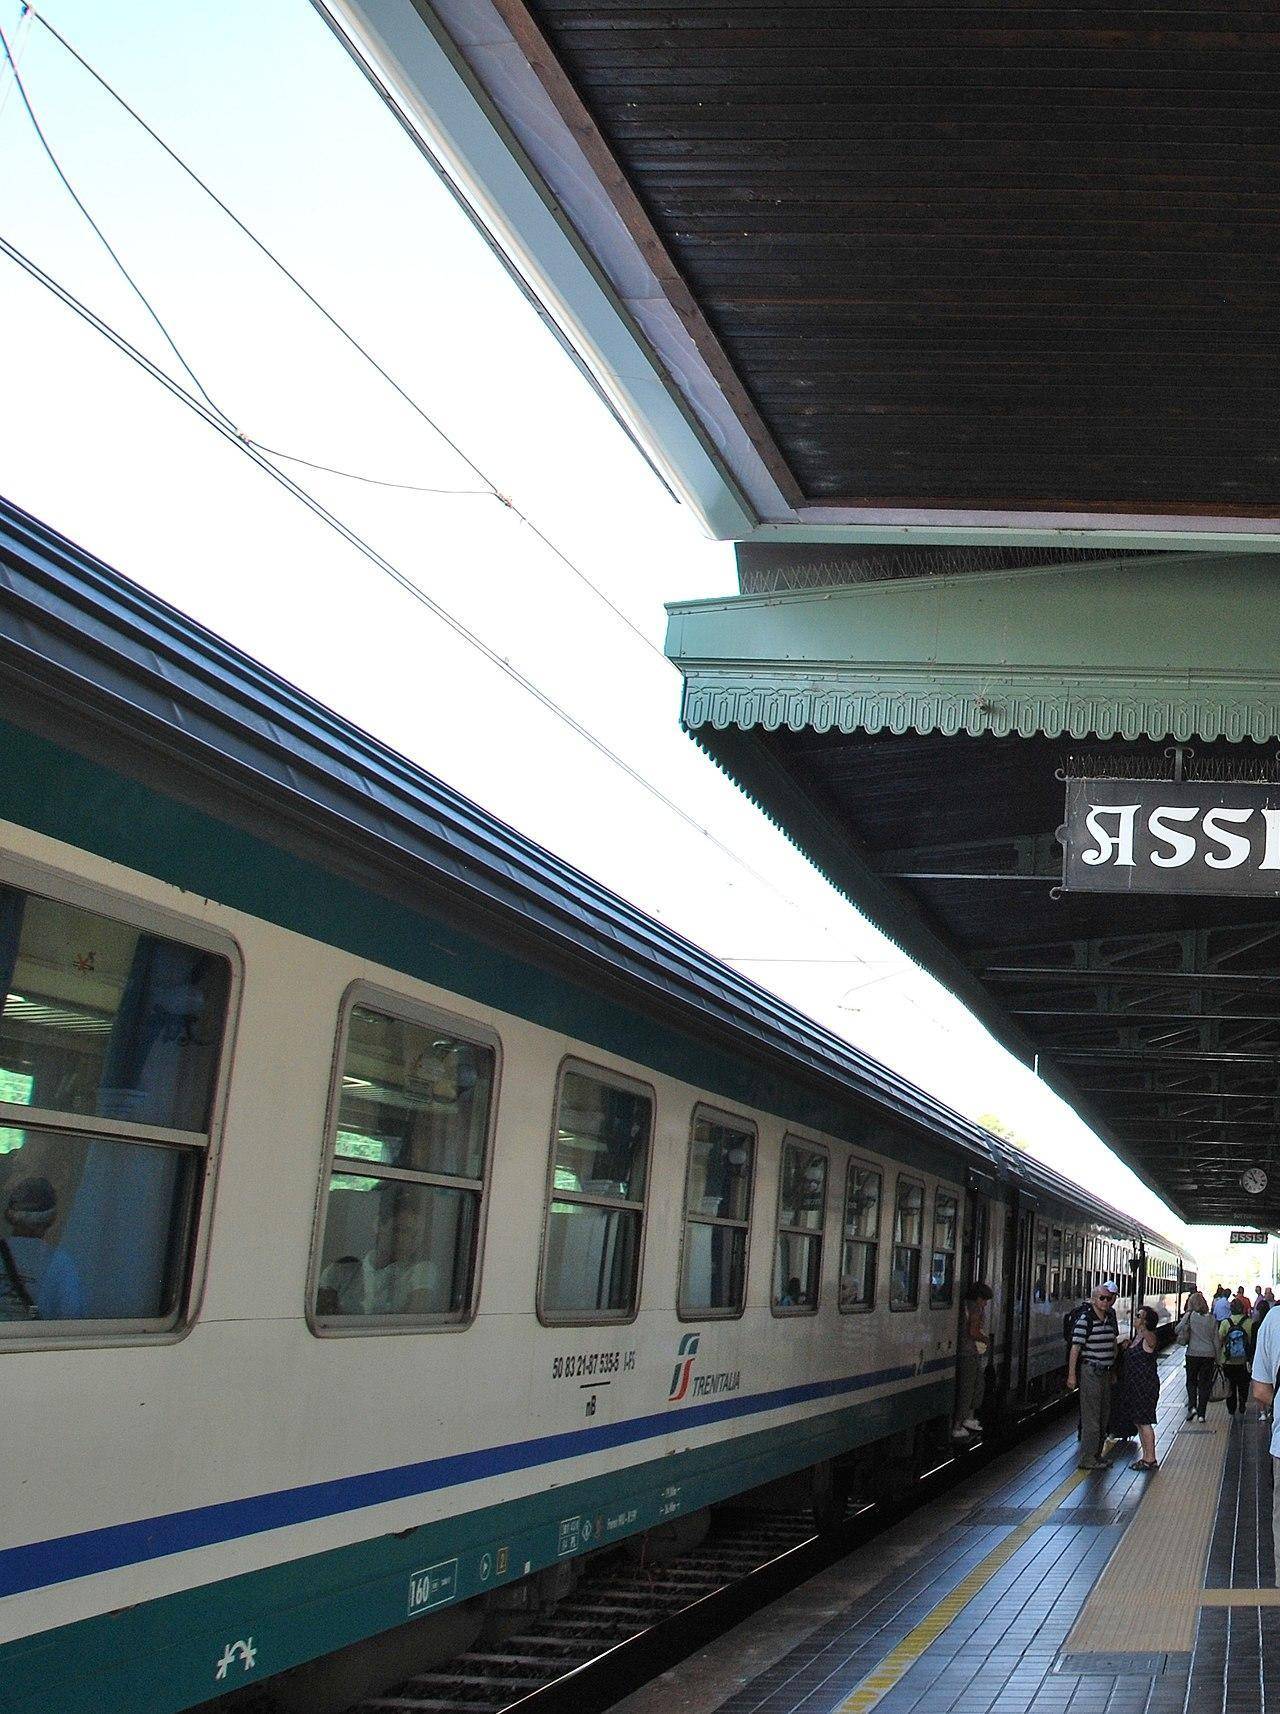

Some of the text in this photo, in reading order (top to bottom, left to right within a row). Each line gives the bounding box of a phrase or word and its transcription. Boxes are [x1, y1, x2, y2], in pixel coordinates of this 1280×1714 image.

[552, 1357, 563, 1379] 50
[565, 1356, 575, 1378] 83
[692, 1371, 740, 1397] TRENITALIA
[410, 1576, 430, 1608] 160
